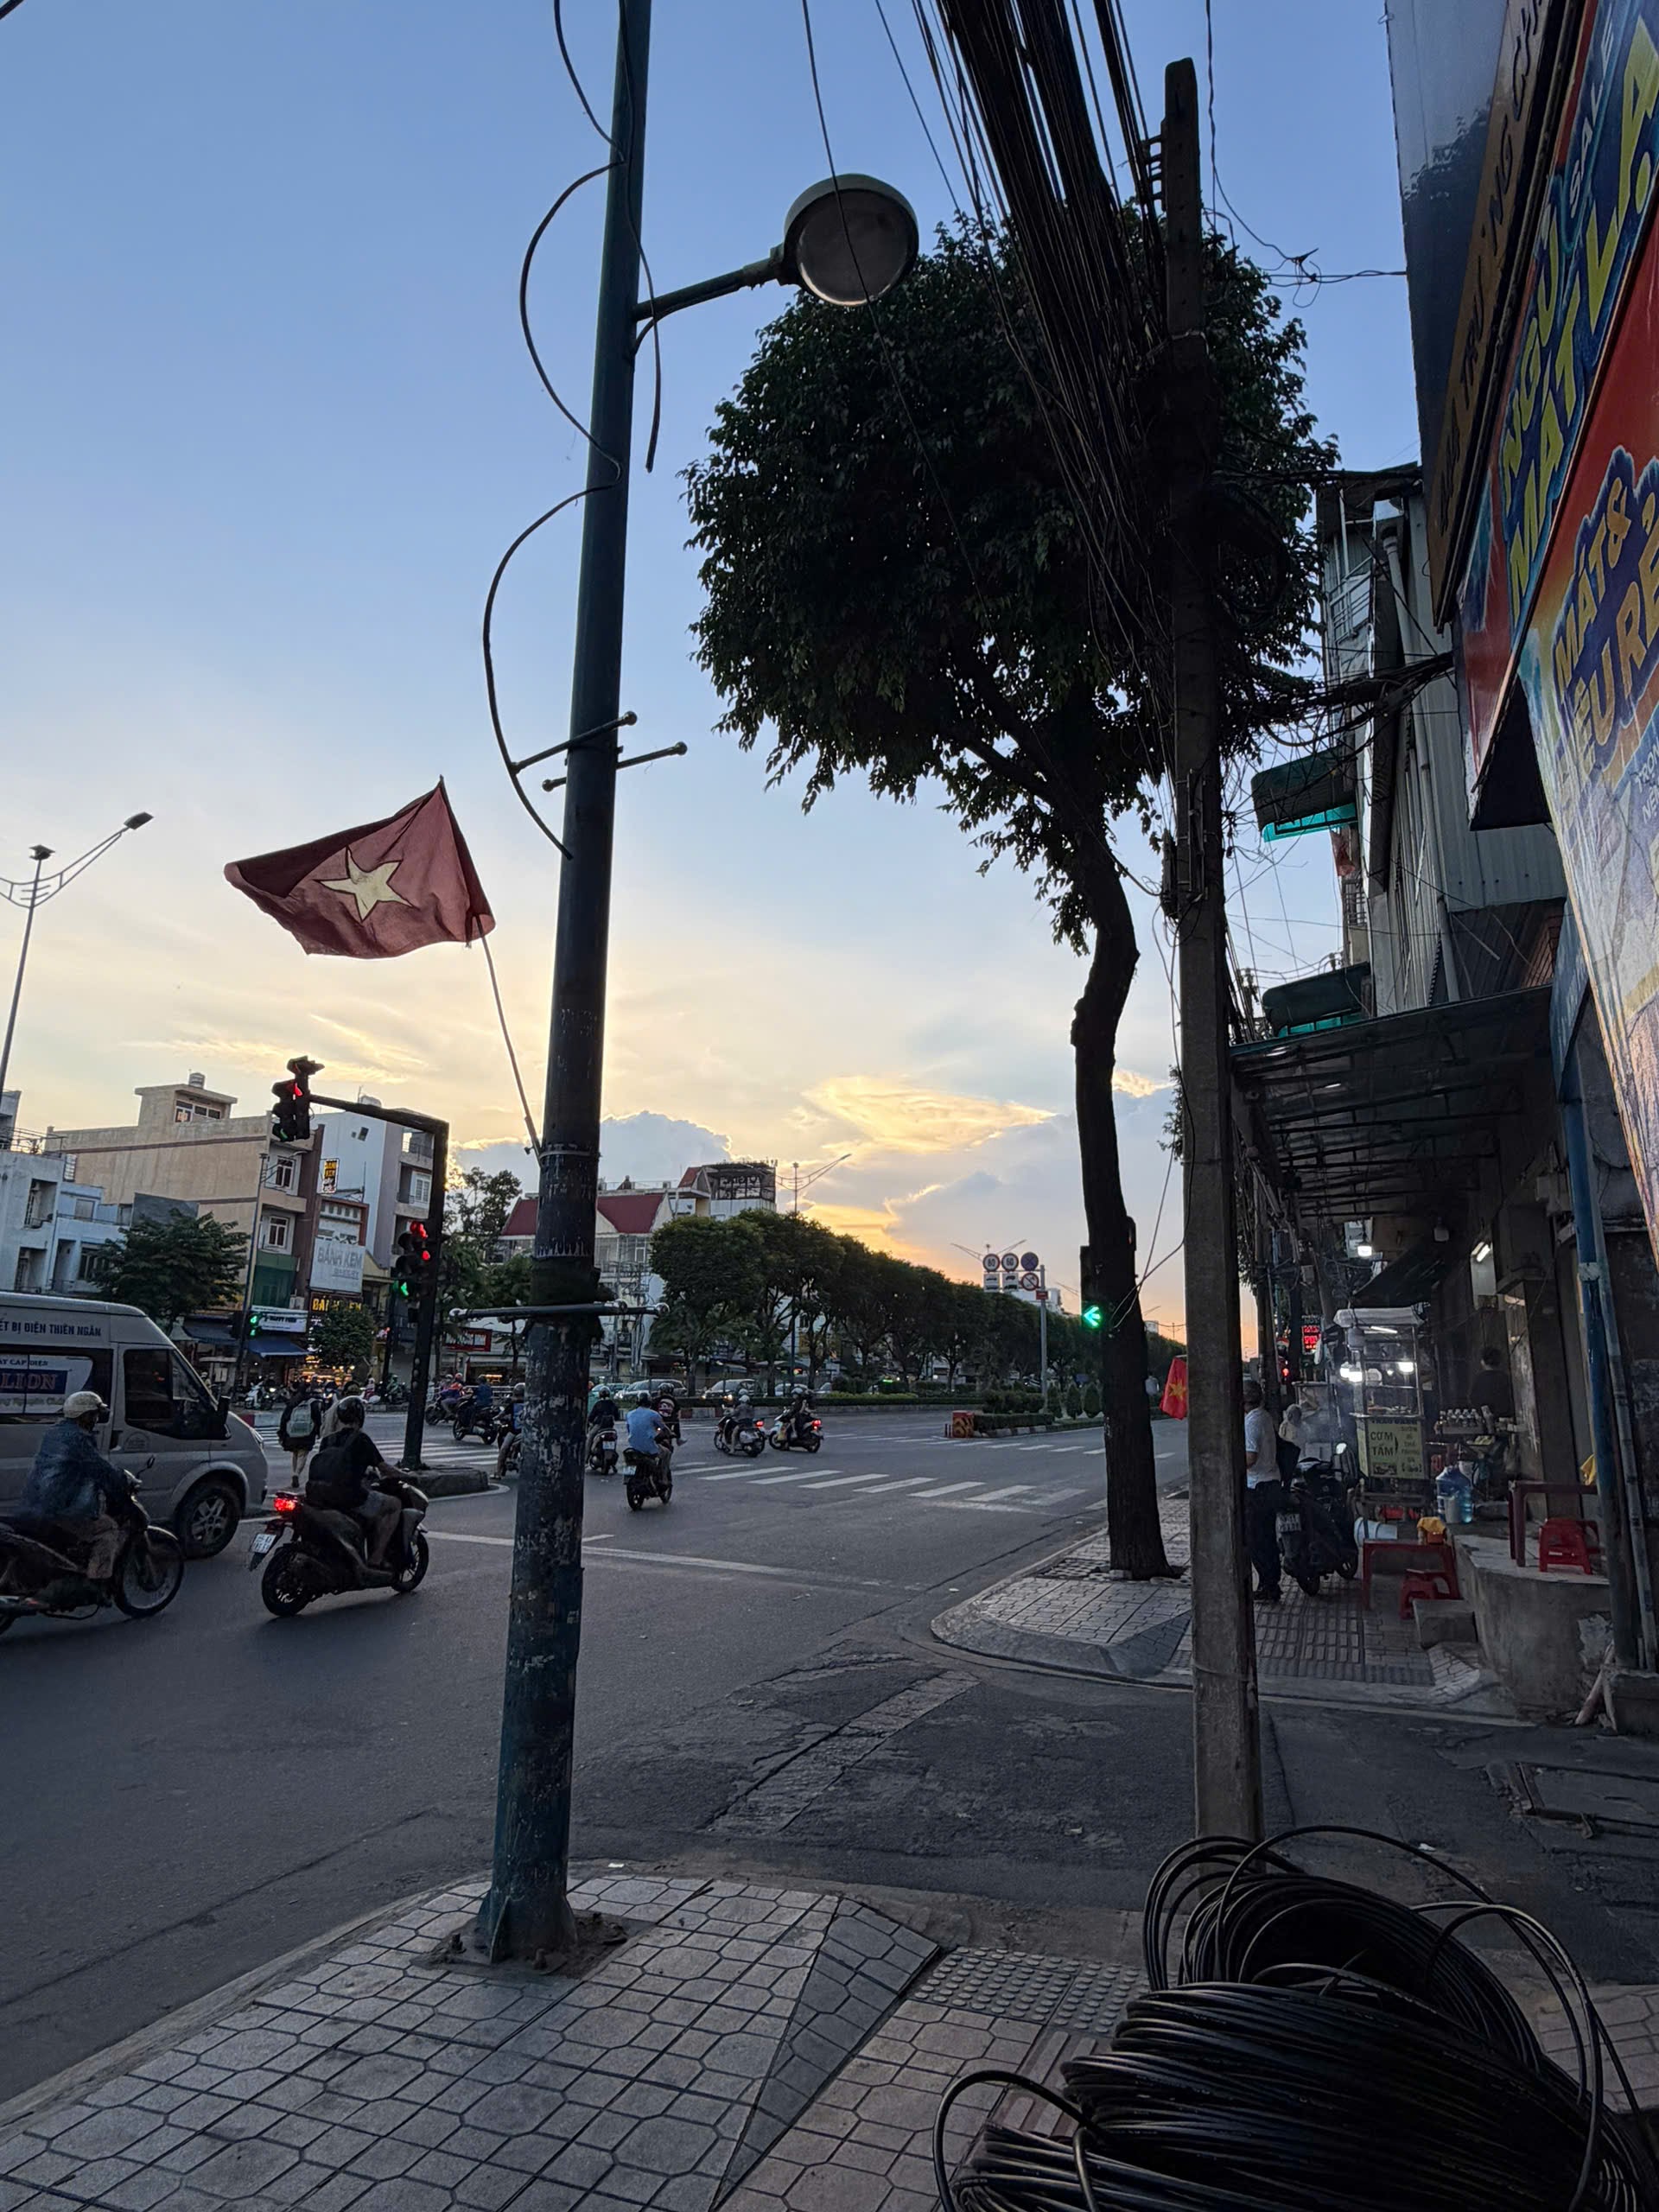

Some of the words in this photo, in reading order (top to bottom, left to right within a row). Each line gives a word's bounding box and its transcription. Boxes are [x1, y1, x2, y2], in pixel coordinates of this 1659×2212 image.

[1569, 2, 1614, 219] SALE
[1510, 270, 1580, 631] MÁT
[12, 1321, 21, 1335] BỊ
[49, 1323, 74, 1335] THIÊN
